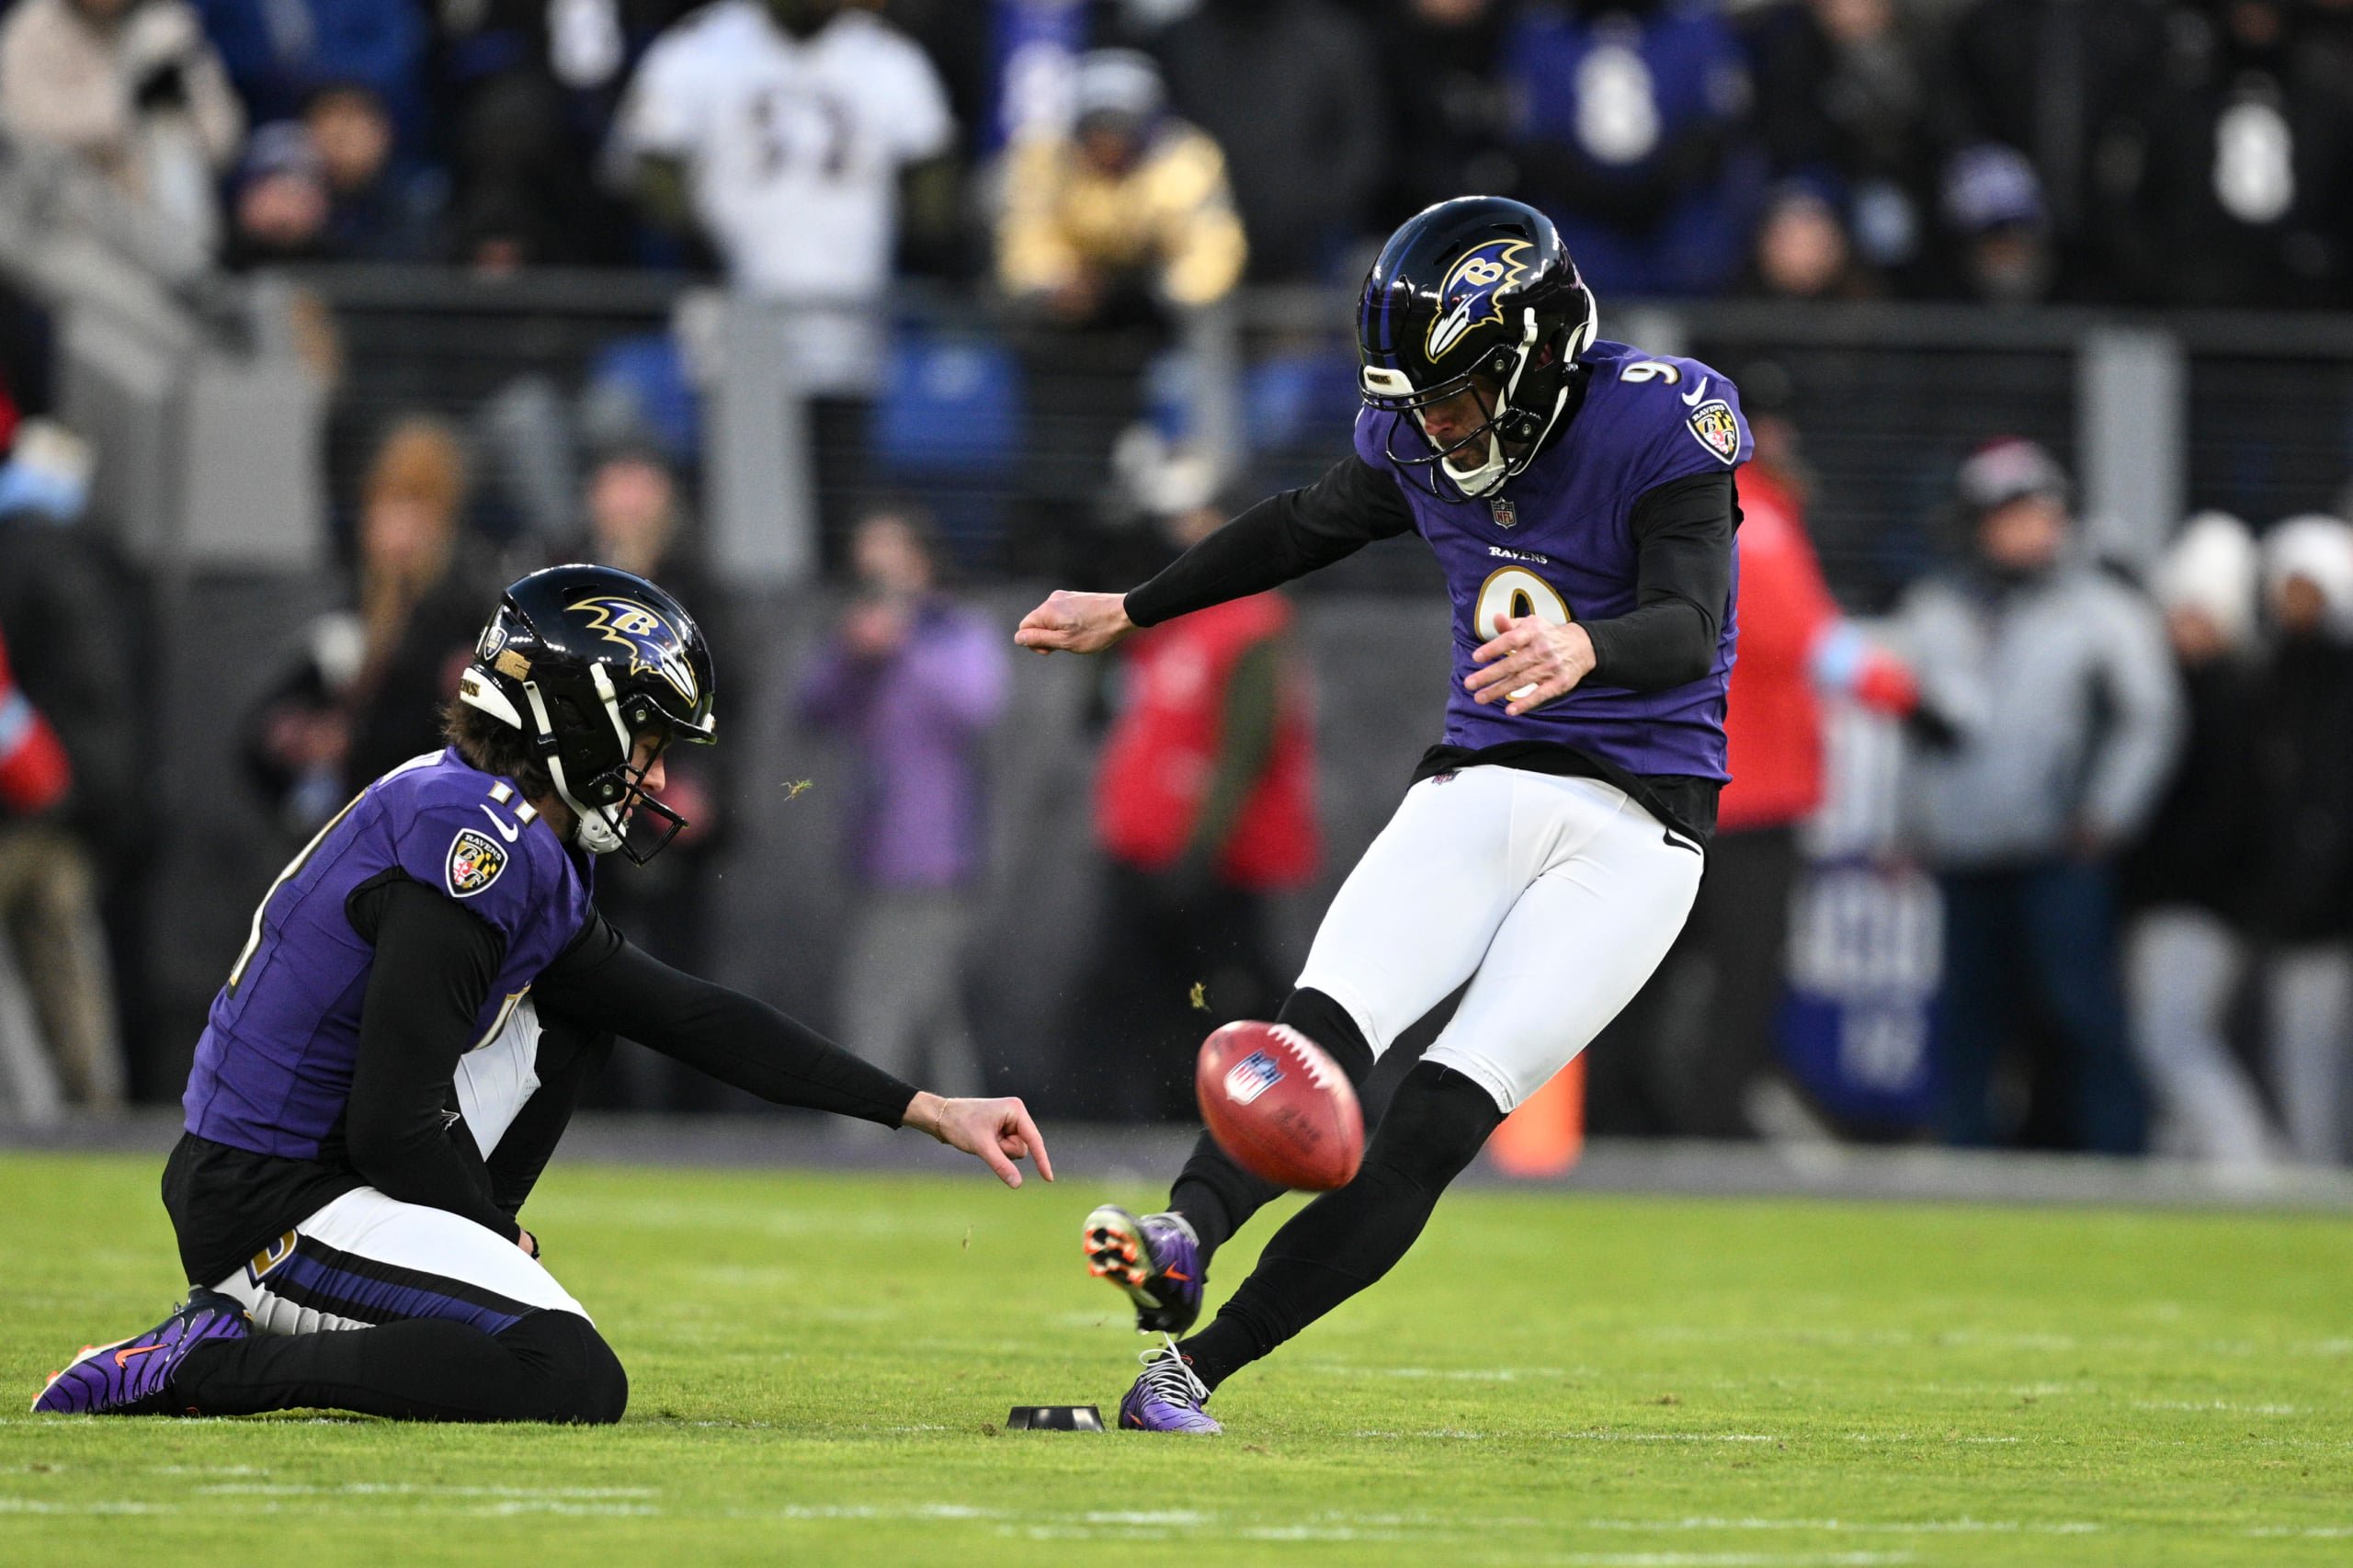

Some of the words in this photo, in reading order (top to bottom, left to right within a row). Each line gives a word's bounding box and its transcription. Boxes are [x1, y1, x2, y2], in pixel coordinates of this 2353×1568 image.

[1620, 361, 1681, 385] 9
[1691, 404, 1725, 422] RAVENS
[1496, 511, 1515, 523] NFL
[1488, 546, 1548, 564] RAVENS
[464, 834, 503, 861] RAVENS
